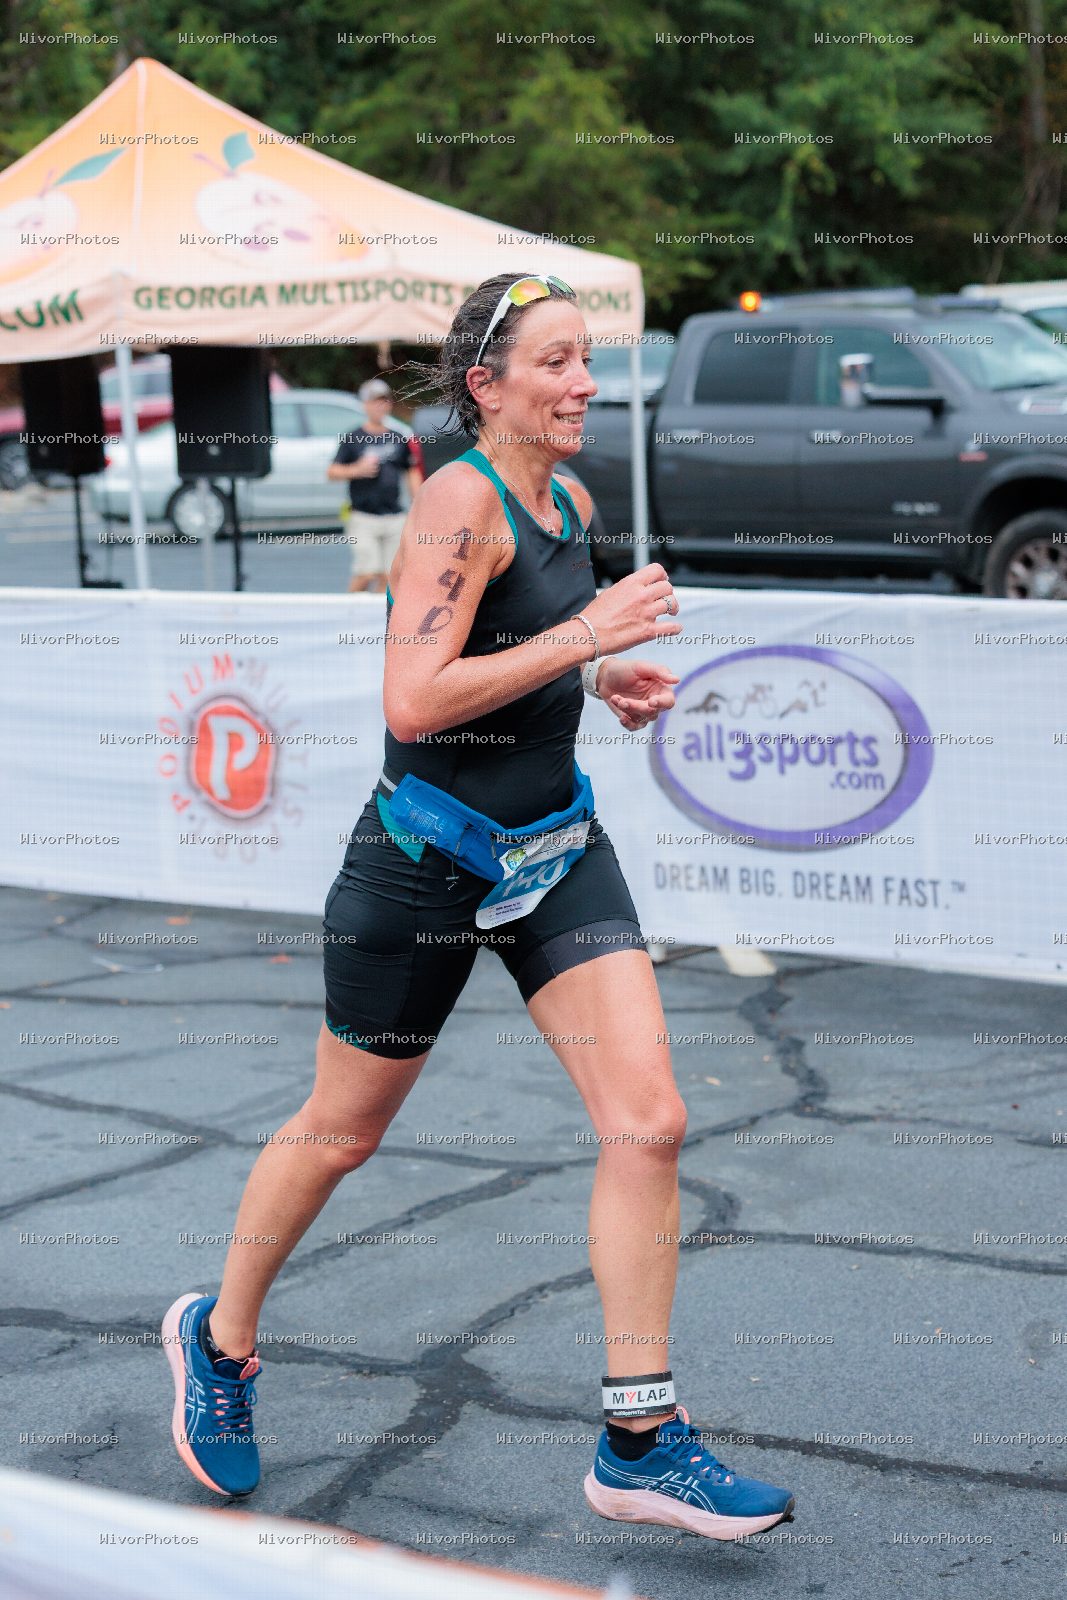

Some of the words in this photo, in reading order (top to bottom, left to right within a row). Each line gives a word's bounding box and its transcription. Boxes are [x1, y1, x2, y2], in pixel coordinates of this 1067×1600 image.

[134, 284, 268, 311] GEORGIA
[278, 277, 452, 306] MULTISPORTS
[829, 770, 885, 791] .com
[654, 862, 729, 894] DREAM
[739, 867, 783, 898] BIG.
[793, 870, 872, 905] DREAM
